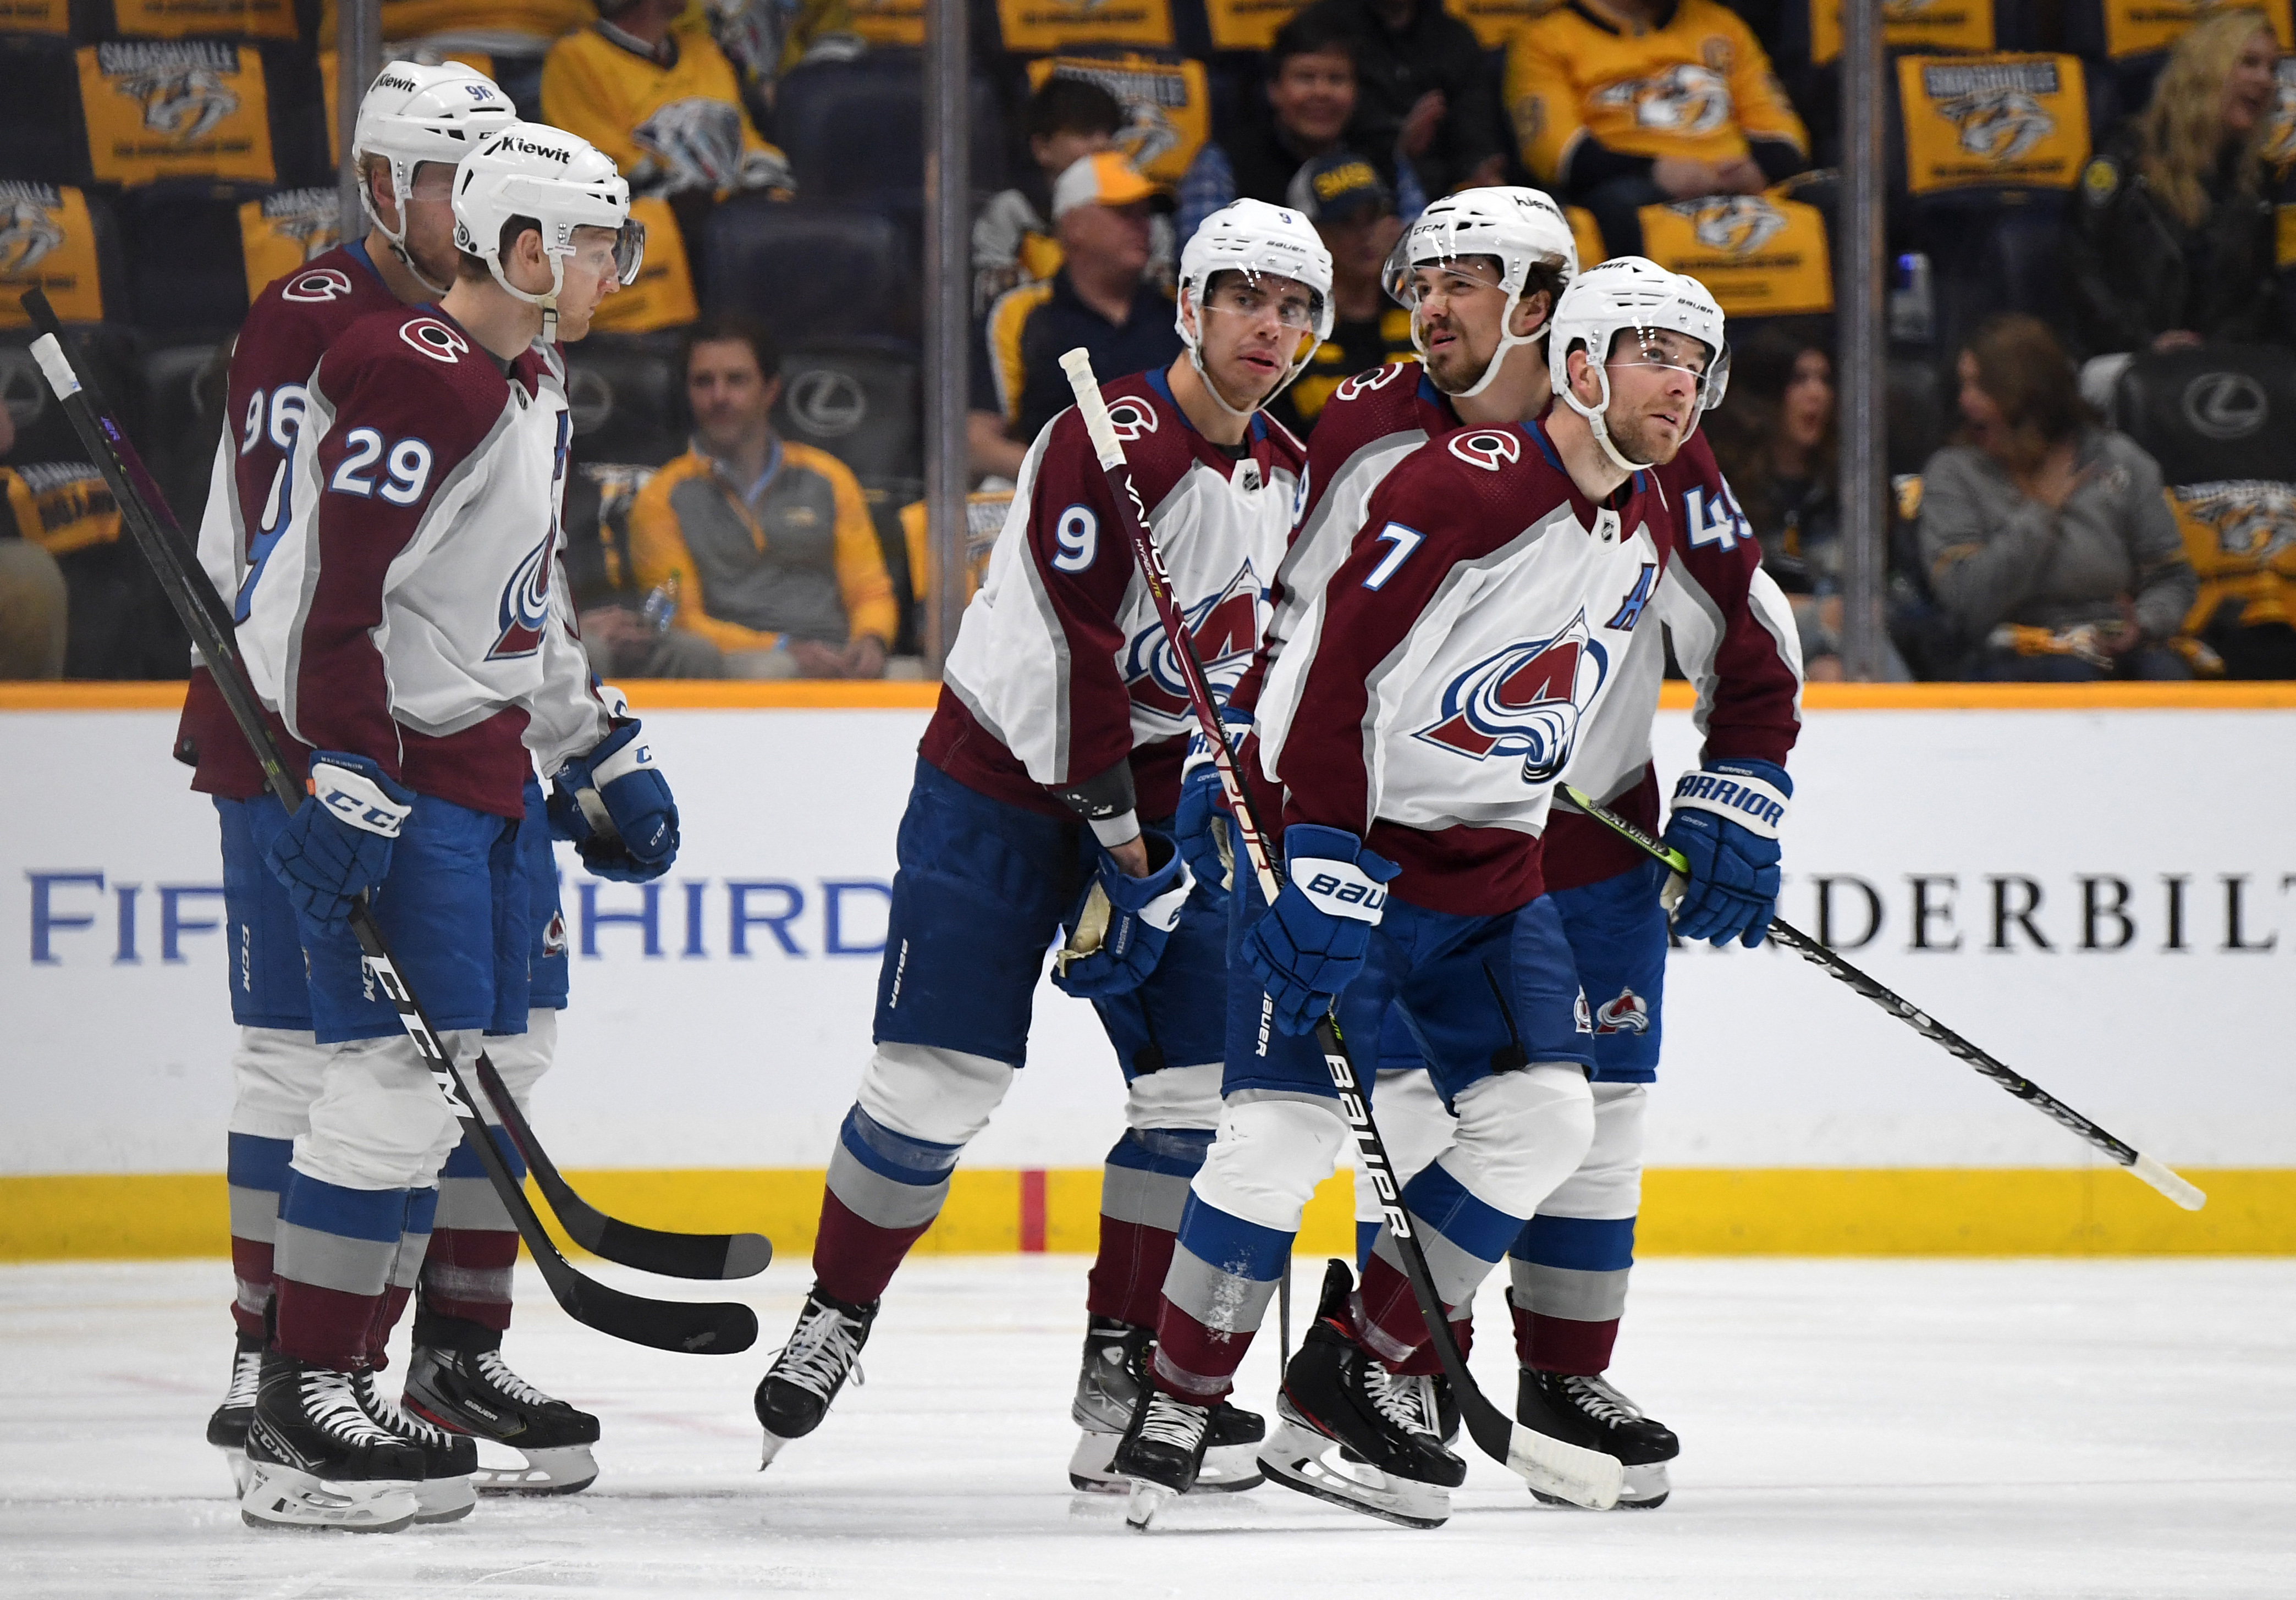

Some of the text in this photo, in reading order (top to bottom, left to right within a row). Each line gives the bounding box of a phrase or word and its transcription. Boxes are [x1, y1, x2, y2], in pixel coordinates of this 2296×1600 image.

[465, 85, 495, 101] 96
[501, 136, 570, 164] Kiewit
[1267, 240, 1306, 253] BAUER
[1279, 212, 1292, 224] 9
[1413, 223, 1446, 236] CCM
[1678, 297, 1714, 315] BAUER
[241, 383, 309, 456] 96
[328, 426, 434, 506] 29
[1050, 503, 1100, 574] 9
[1136, 538, 1163, 599] HYPERLITE
[1361, 520, 1428, 592] 7
[1604, 562, 1657, 632] A
[555, 869, 894, 961] HIRD
[242, 923, 250, 992] CCM
[360, 944, 376, 1002] CM
[889, 938, 908, 1009] BAUER
[367, 952, 475, 1119] CCM
[1324, 1054, 1412, 1239] BAUER
[252, 1419, 291, 1463] CCM
[464, 1399, 498, 1421] BAUER
